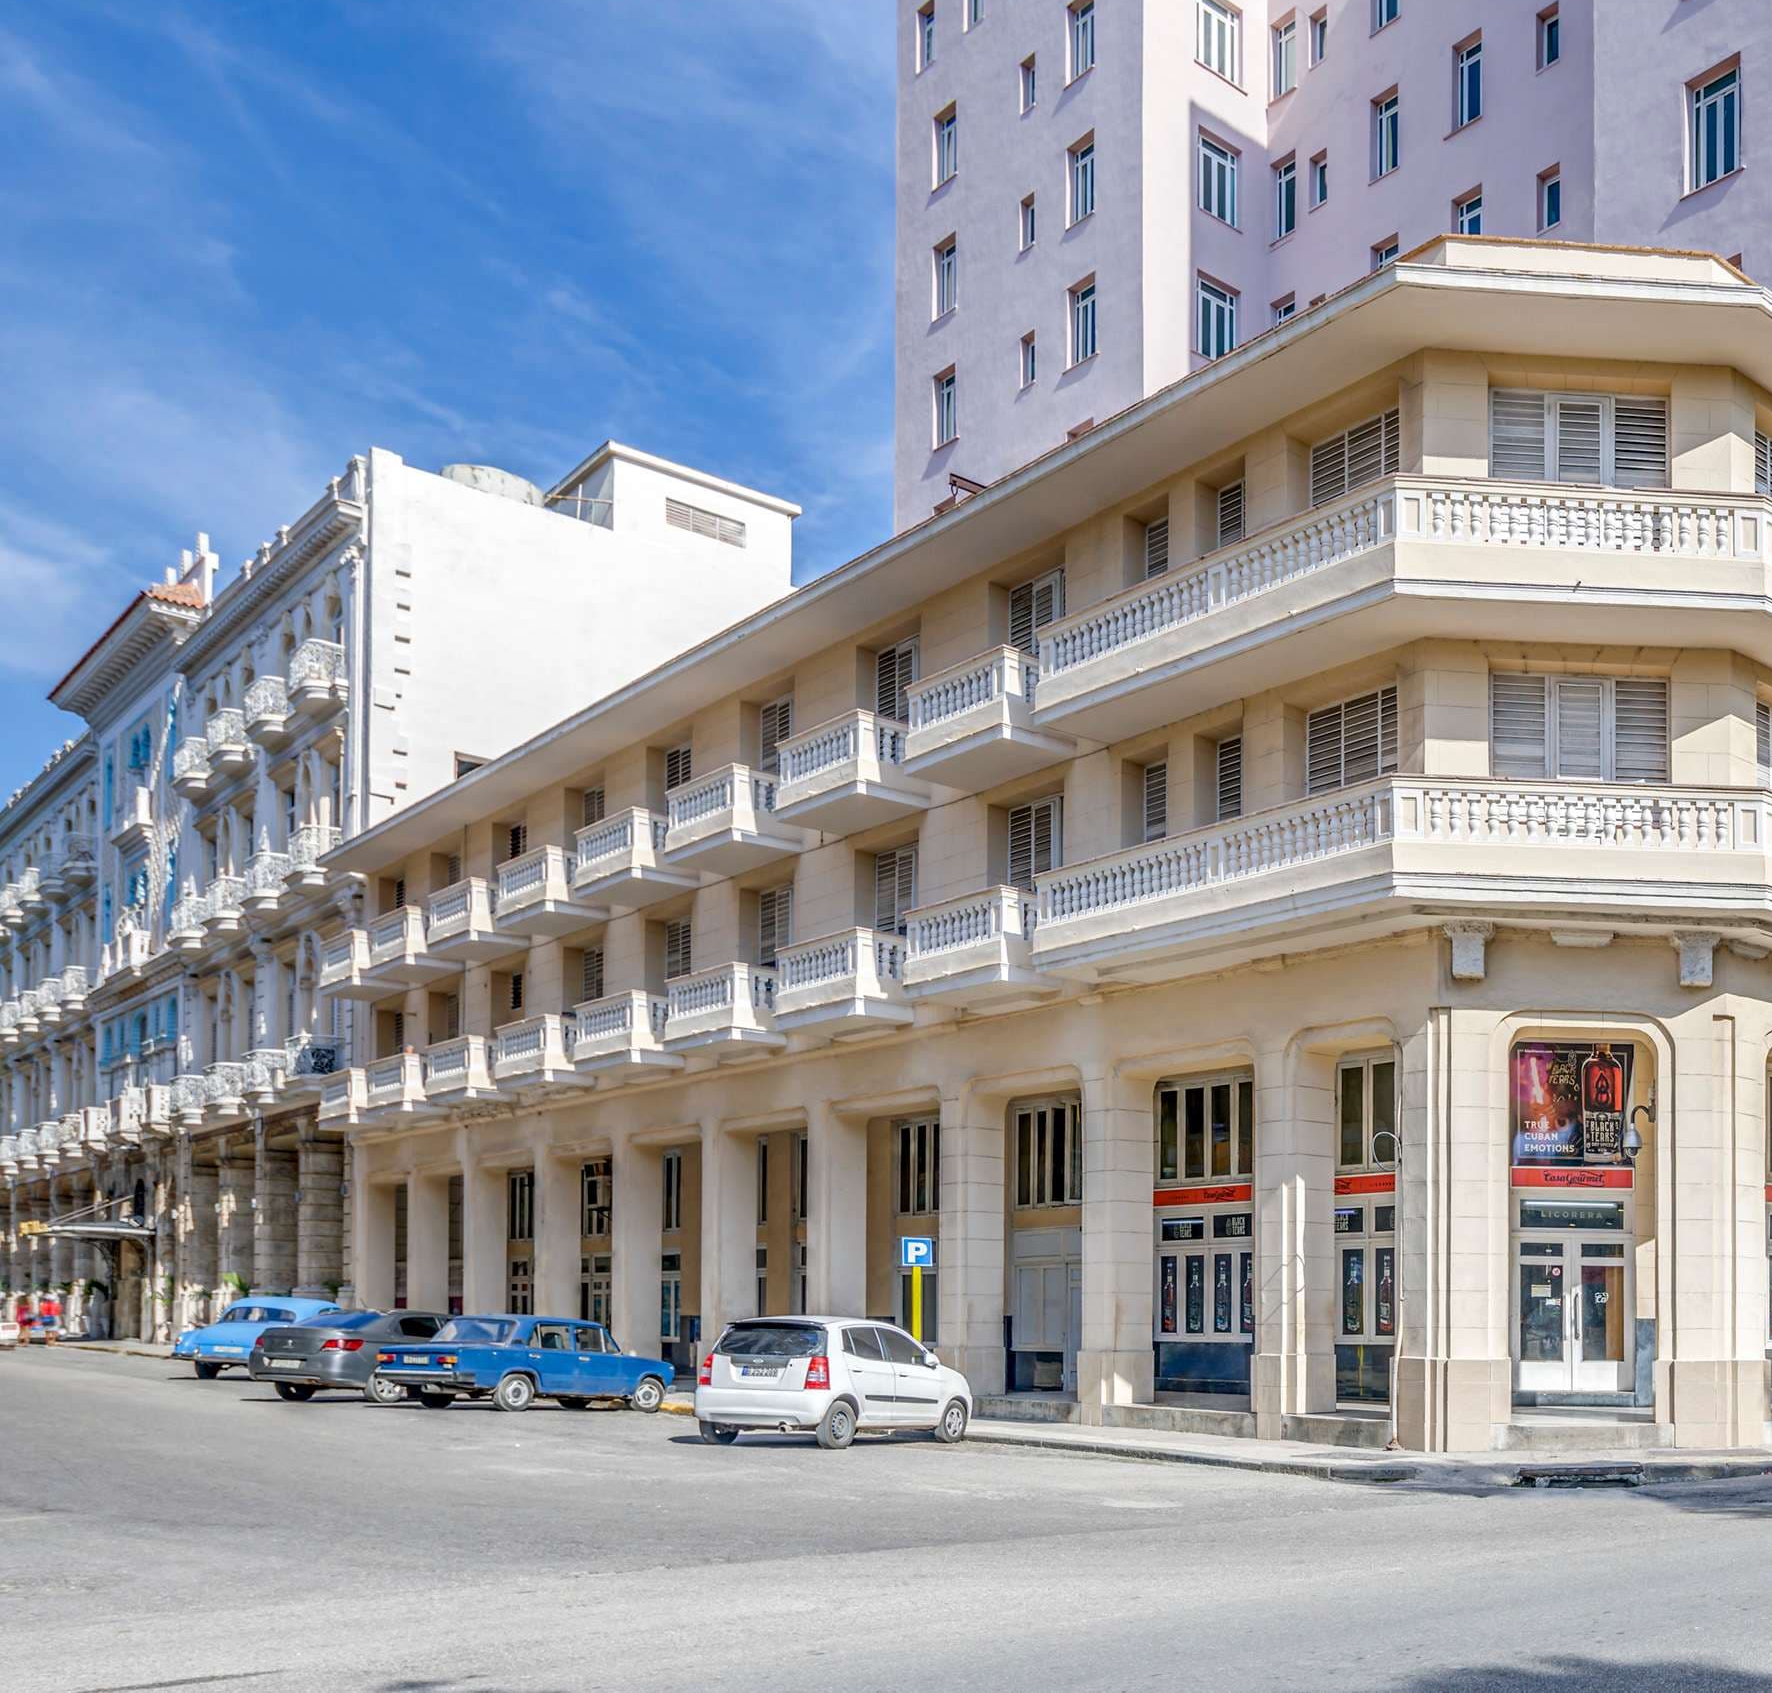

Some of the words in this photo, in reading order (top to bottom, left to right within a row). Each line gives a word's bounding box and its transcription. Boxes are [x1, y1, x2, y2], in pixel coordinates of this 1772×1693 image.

[1590, 1120, 1615, 1132] BLACK
[1524, 1132, 1559, 1141] CUBAN
[1591, 1131, 1615, 1142] TEARS
[1524, 1143, 1576, 1153] EMOTIONS
[1541, 1210, 1603, 1219] LICORERA
[1231, 1216, 1246, 1226] BLACK
[1232, 1226, 1246, 1235] TEARS
[907, 1242, 928, 1263] P
